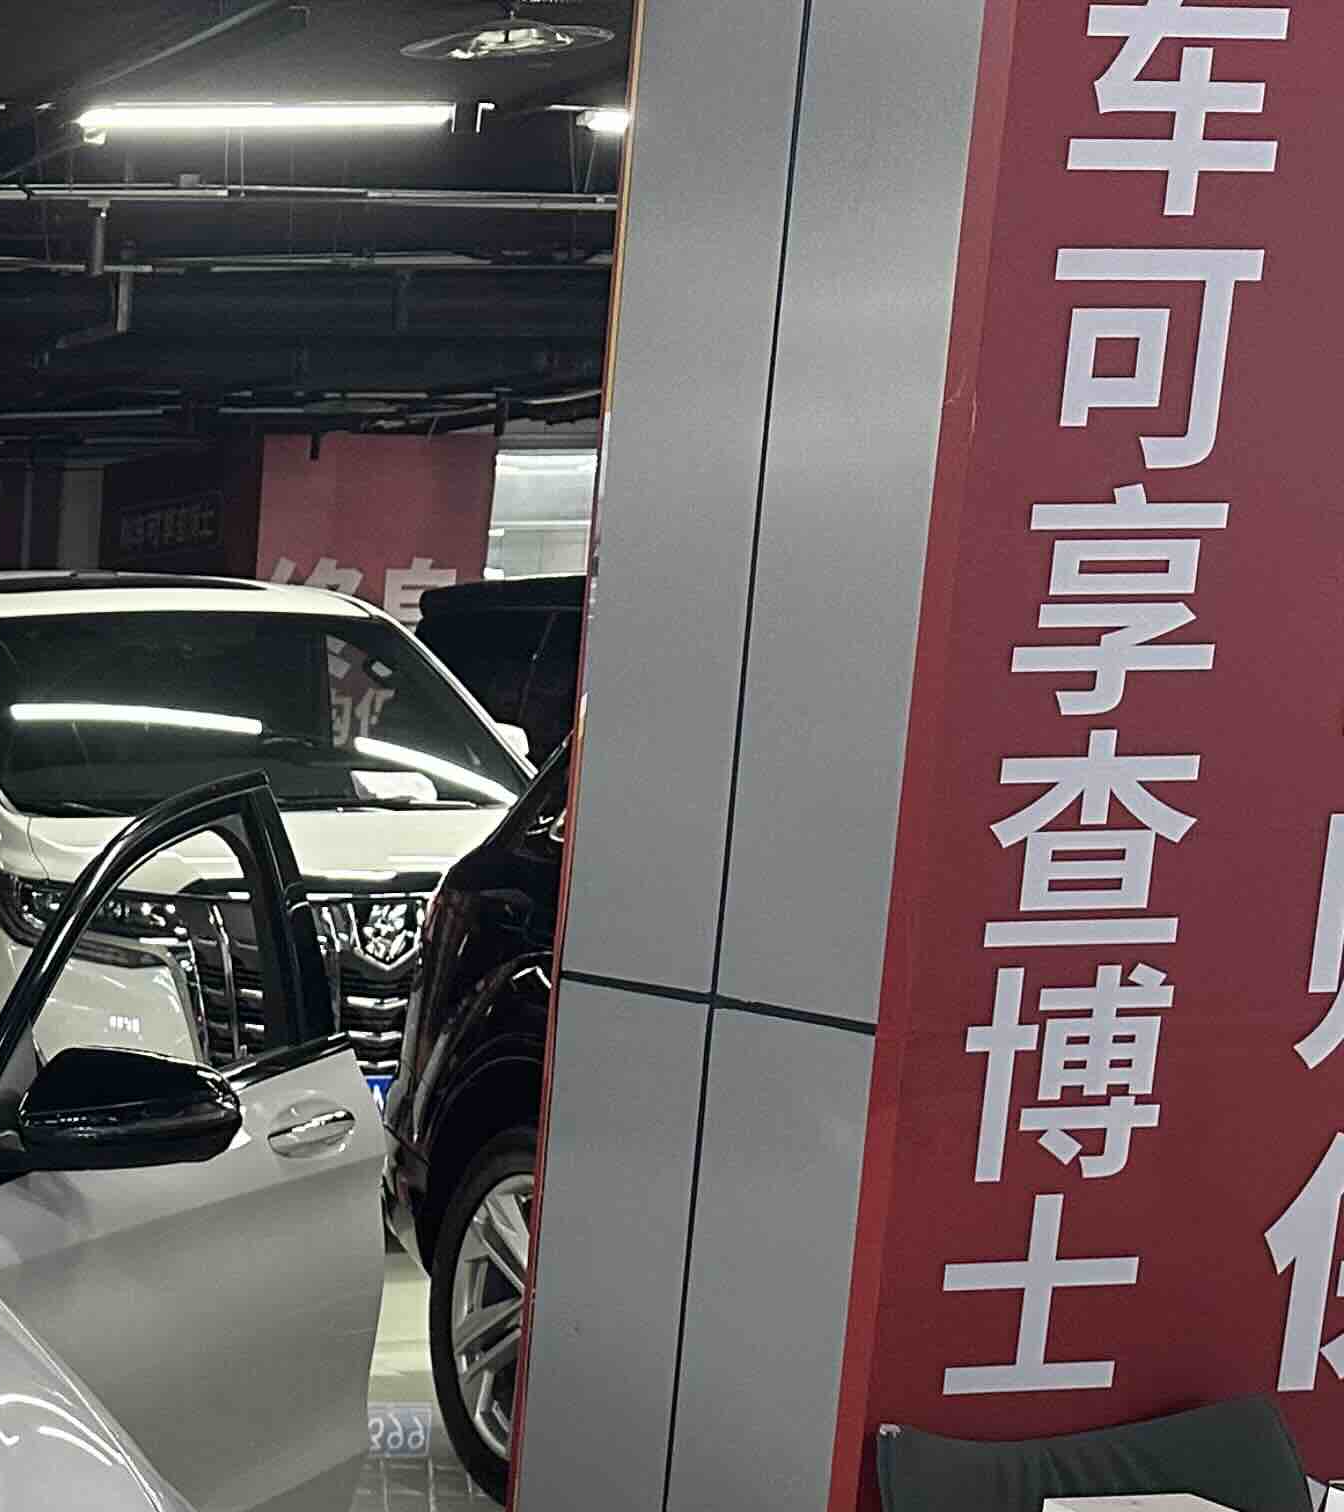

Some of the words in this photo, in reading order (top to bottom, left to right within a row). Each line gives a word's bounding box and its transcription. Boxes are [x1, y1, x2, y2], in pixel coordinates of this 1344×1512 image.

[940, 0, 1291, 1396] 车可享查博士
